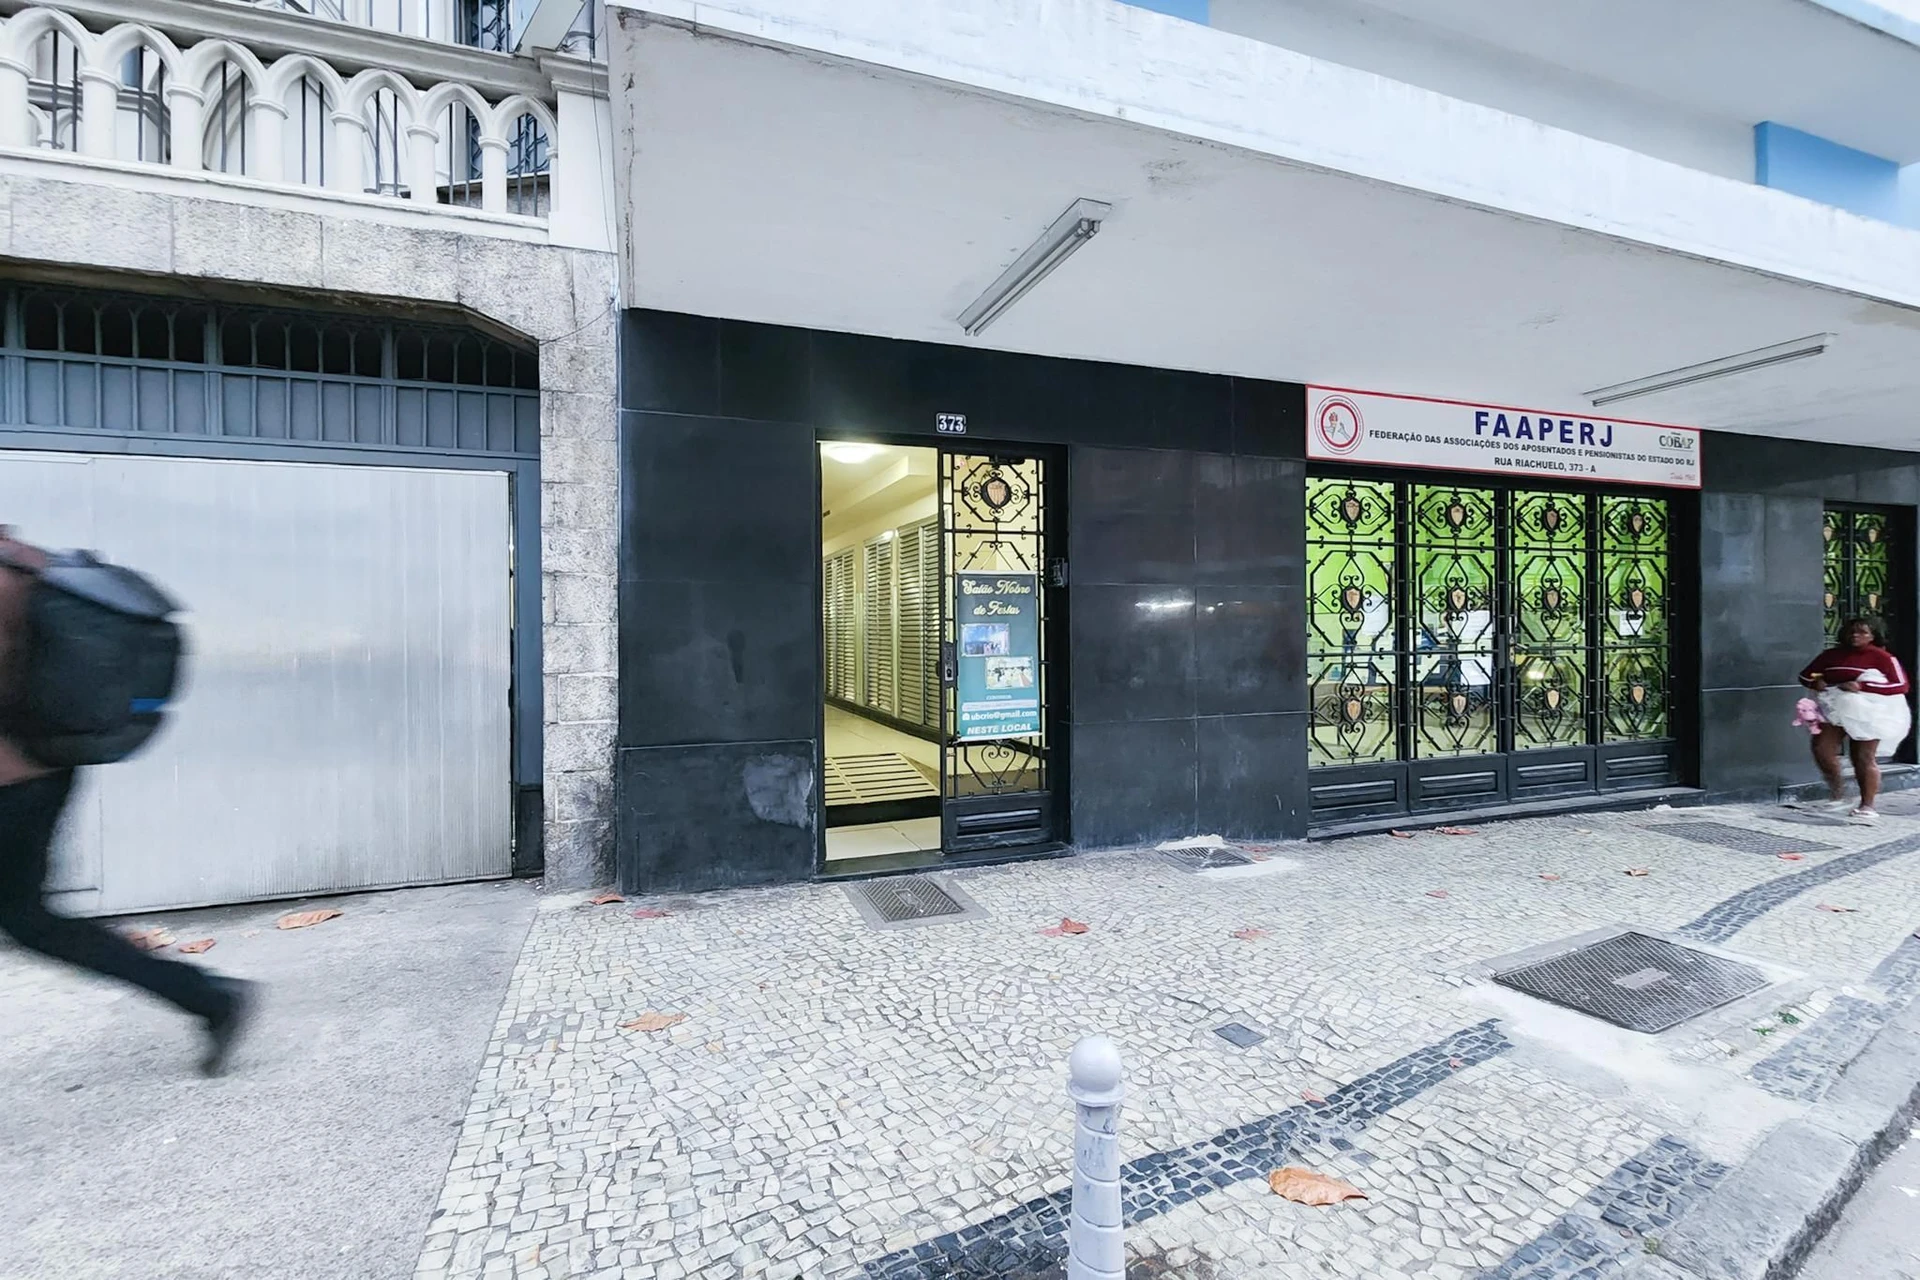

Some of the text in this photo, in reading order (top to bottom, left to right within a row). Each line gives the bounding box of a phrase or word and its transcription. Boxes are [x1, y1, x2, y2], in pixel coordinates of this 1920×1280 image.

[939, 415, 963, 431] 373
[1475, 411, 1612, 448] FAAPERJ
[1369, 430, 1422, 443] FEDERAÇÃO
[1425, 435, 1441, 444] DAS
[1443, 437, 1501, 450] ASSOCIAÇÕES
[1503, 443, 1519, 451] DOS
[1521, 444, 1576, 456] APOSENTADOS
[1578, 449, 1583, 457] E
[1584, 450, 1636, 461] PENSIONISTAS
[1637, 454, 1646, 462] DO
[1648, 455, 1674, 465] ESTADO
[1494, 457, 1513, 467] RUA
[1515, 458, 1567, 472] RIACHUELO,
[1569, 463, 1584, 472] 373
[1590, 465, 1596, 473] A
[962, 579, 993, 595] Salão
[987, 601, 1020, 615] Festas
[967, 723, 1032, 735] NESTE LOCAL
